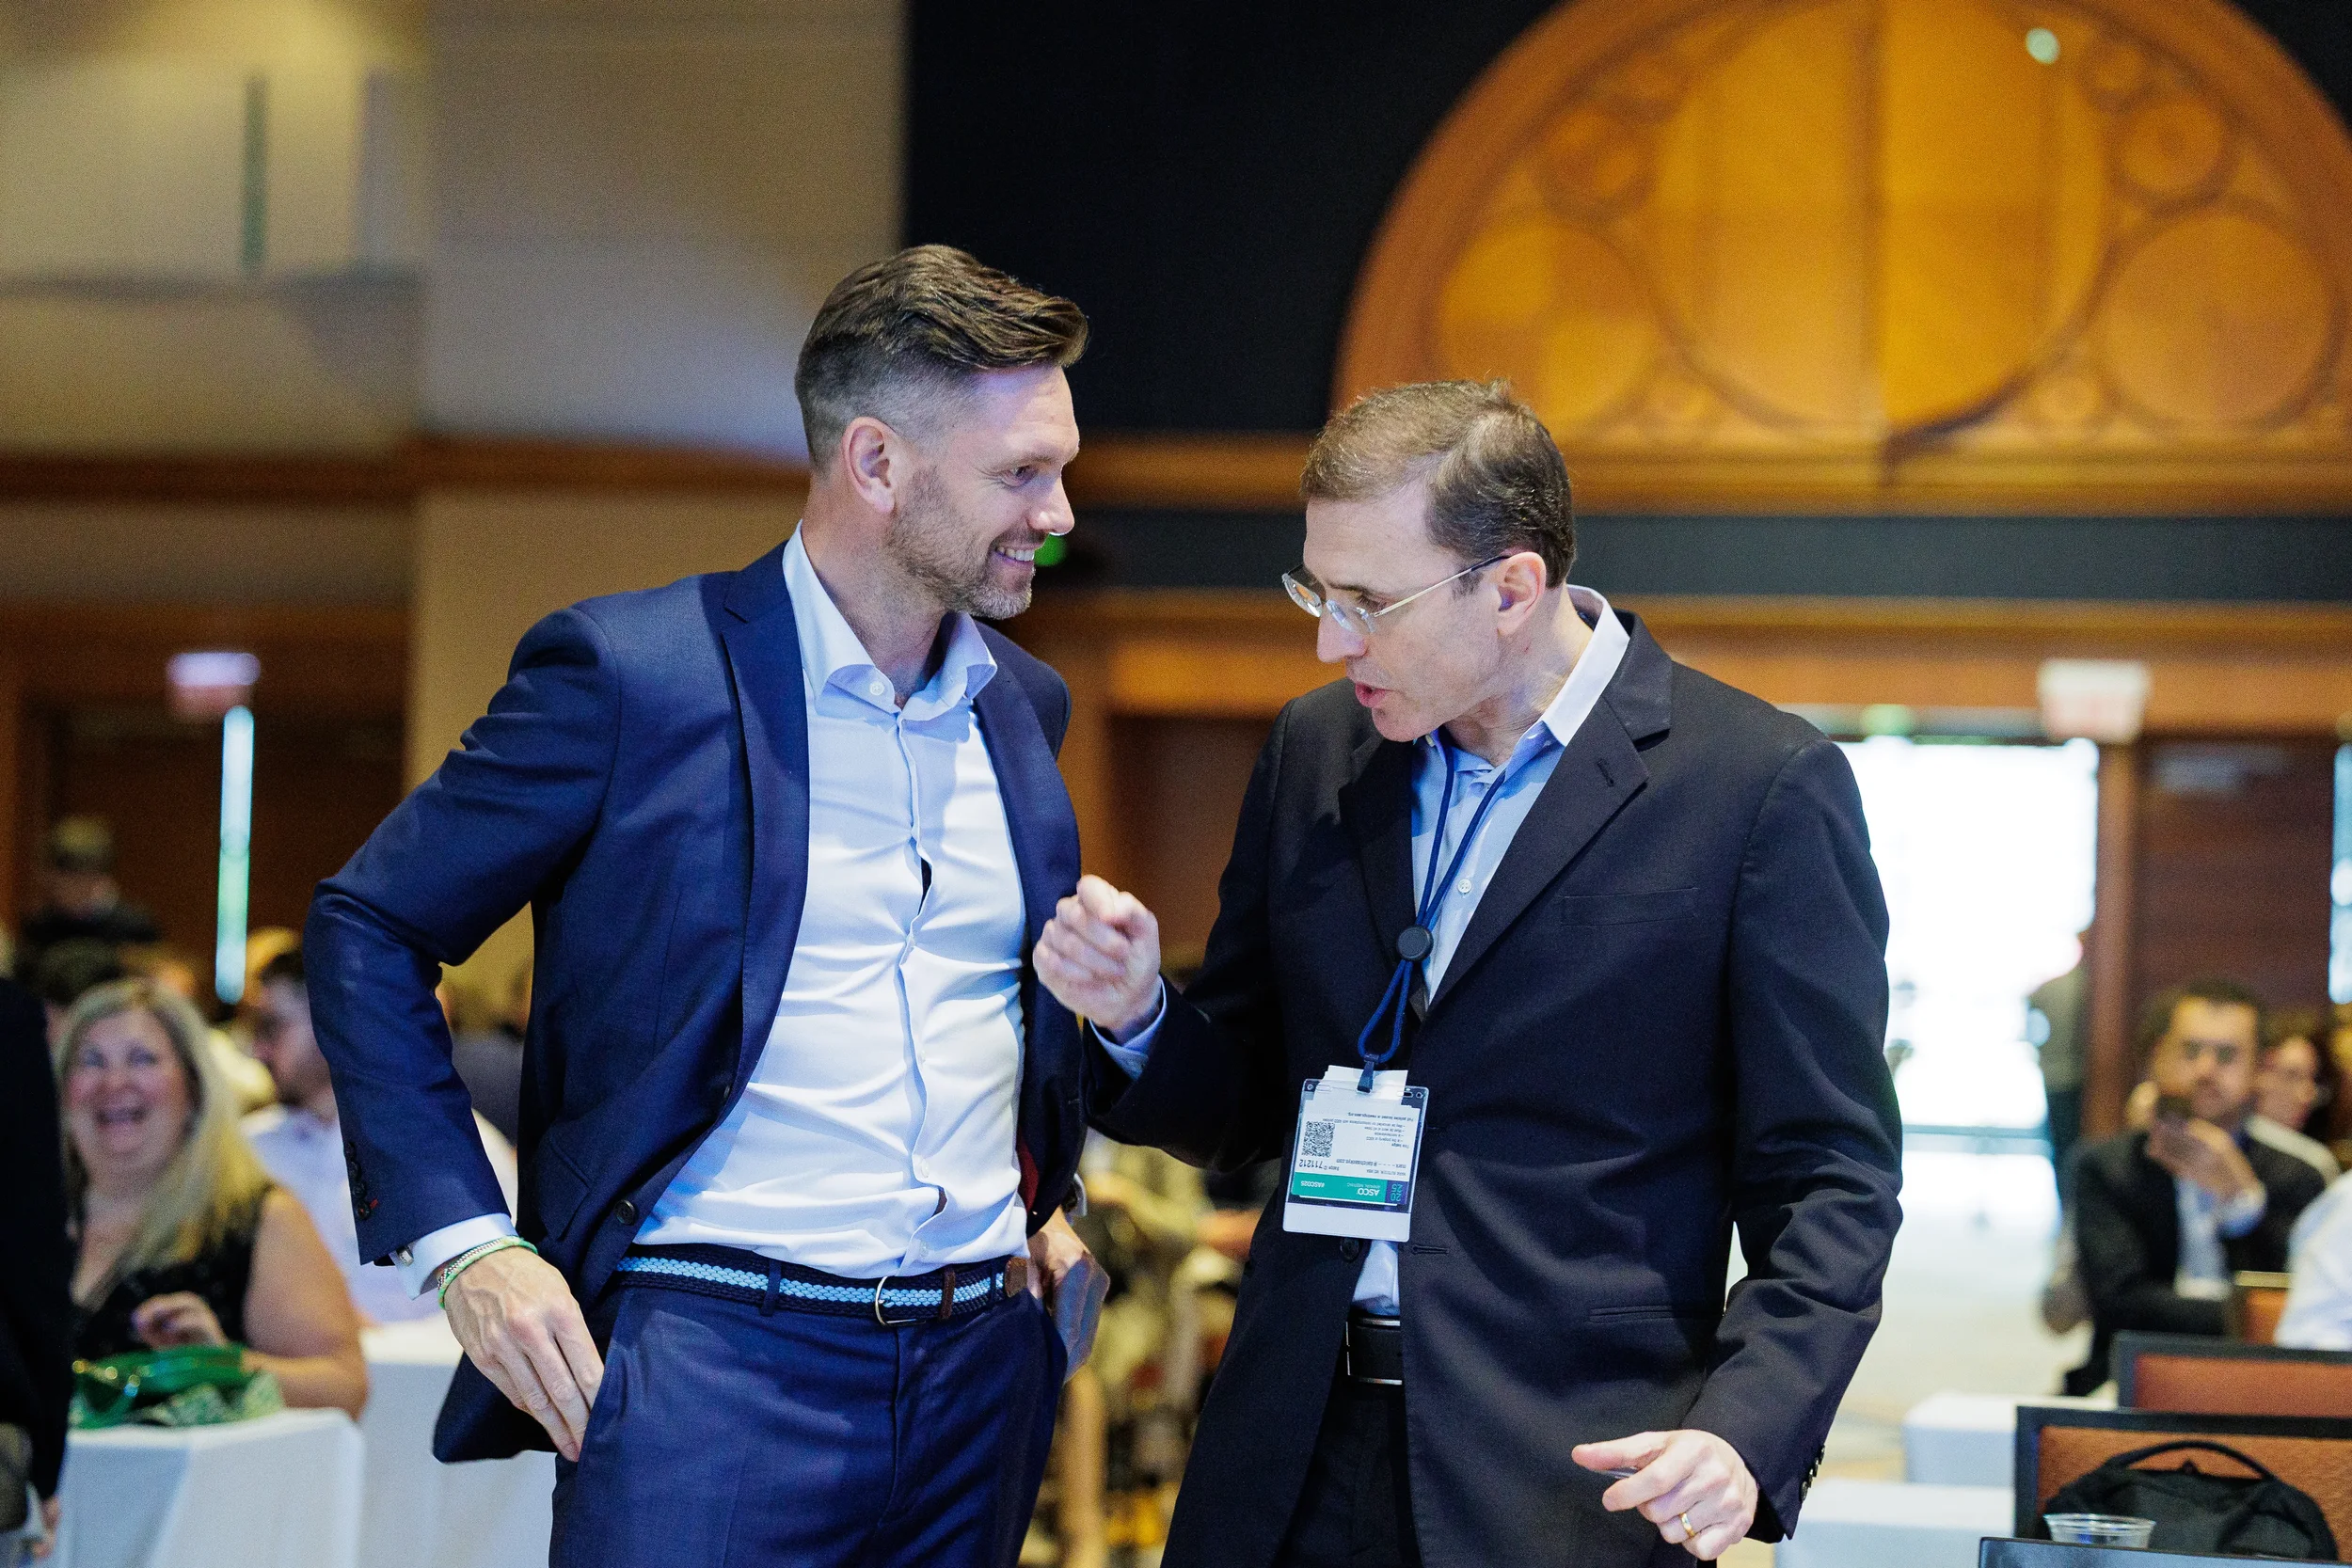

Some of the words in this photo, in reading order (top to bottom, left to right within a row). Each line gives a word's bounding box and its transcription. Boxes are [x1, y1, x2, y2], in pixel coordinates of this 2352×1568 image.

[1298, 1159, 1322, 1168] 711212
[1357, 1187, 1379, 1196] ASCO
[1391, 1183, 1403, 1192] 25
[1390, 1192, 1401, 1201] 20
